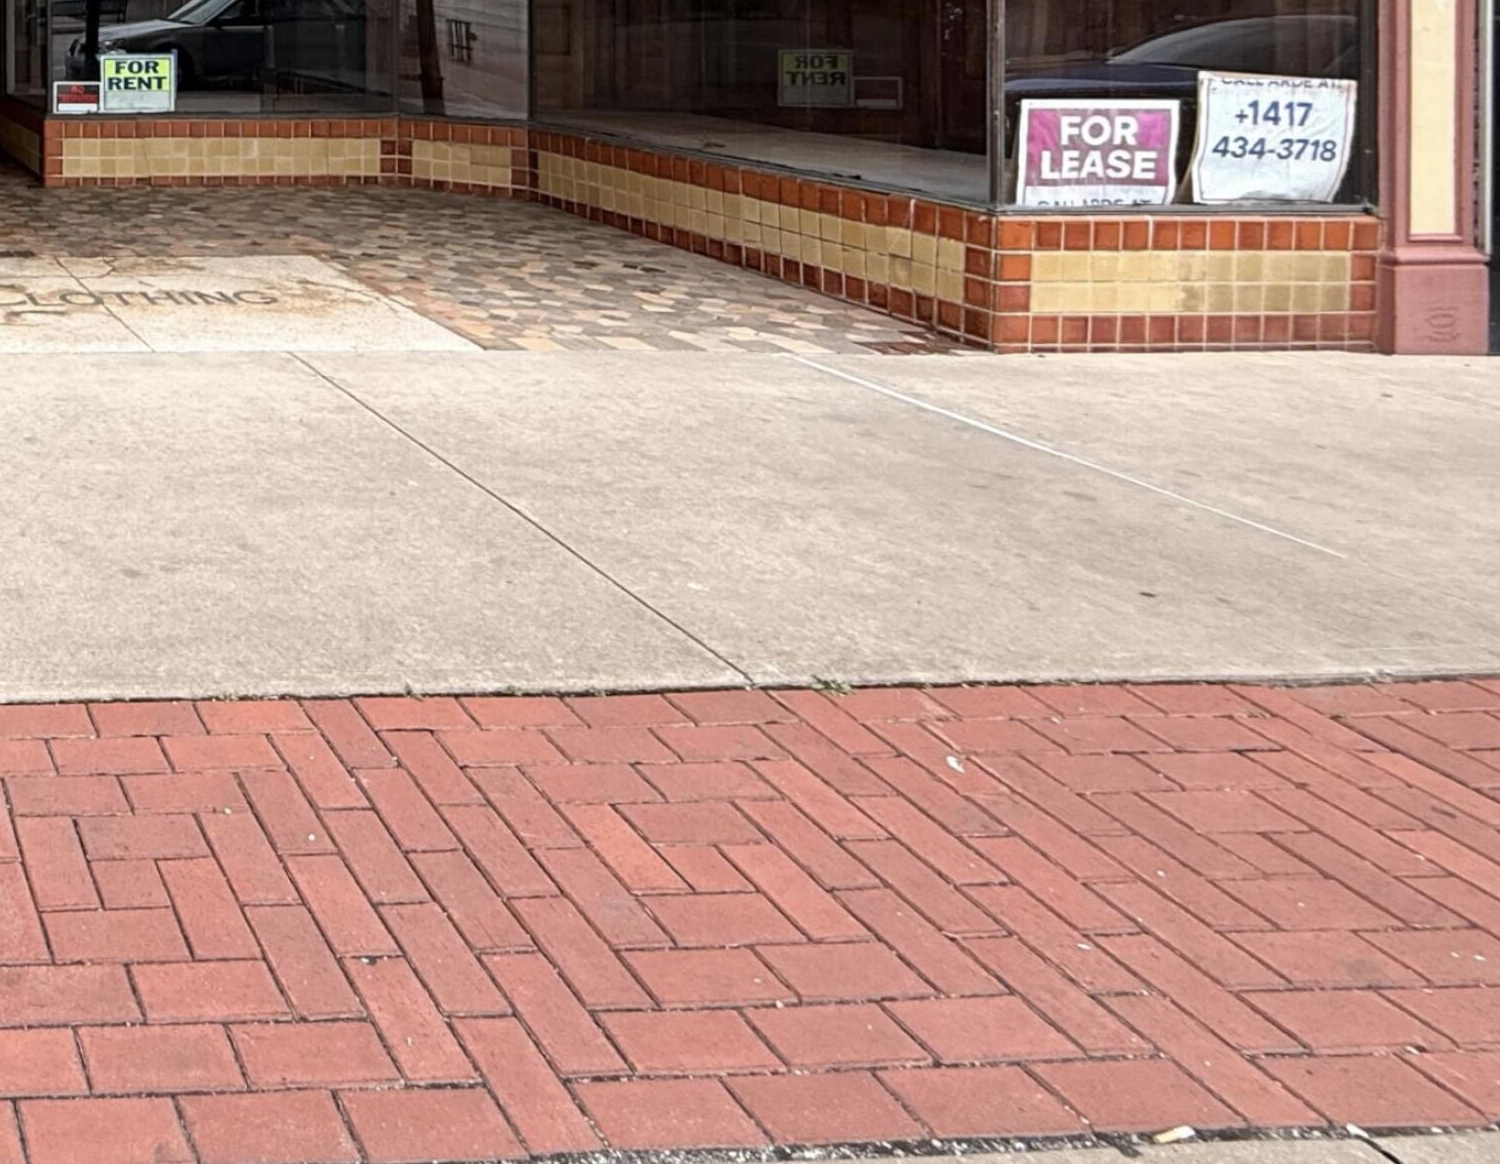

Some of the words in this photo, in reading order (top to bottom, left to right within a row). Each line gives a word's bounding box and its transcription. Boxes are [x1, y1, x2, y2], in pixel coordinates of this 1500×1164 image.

[114, 60, 160, 74] FOR
[107, 76, 168, 91] RENT
[1234, 99, 1313, 127] +1417
[1060, 115, 1139, 146] FOR
[1211, 136, 1338, 162] 434-3718
[1041, 149, 1157, 180] LEASE
